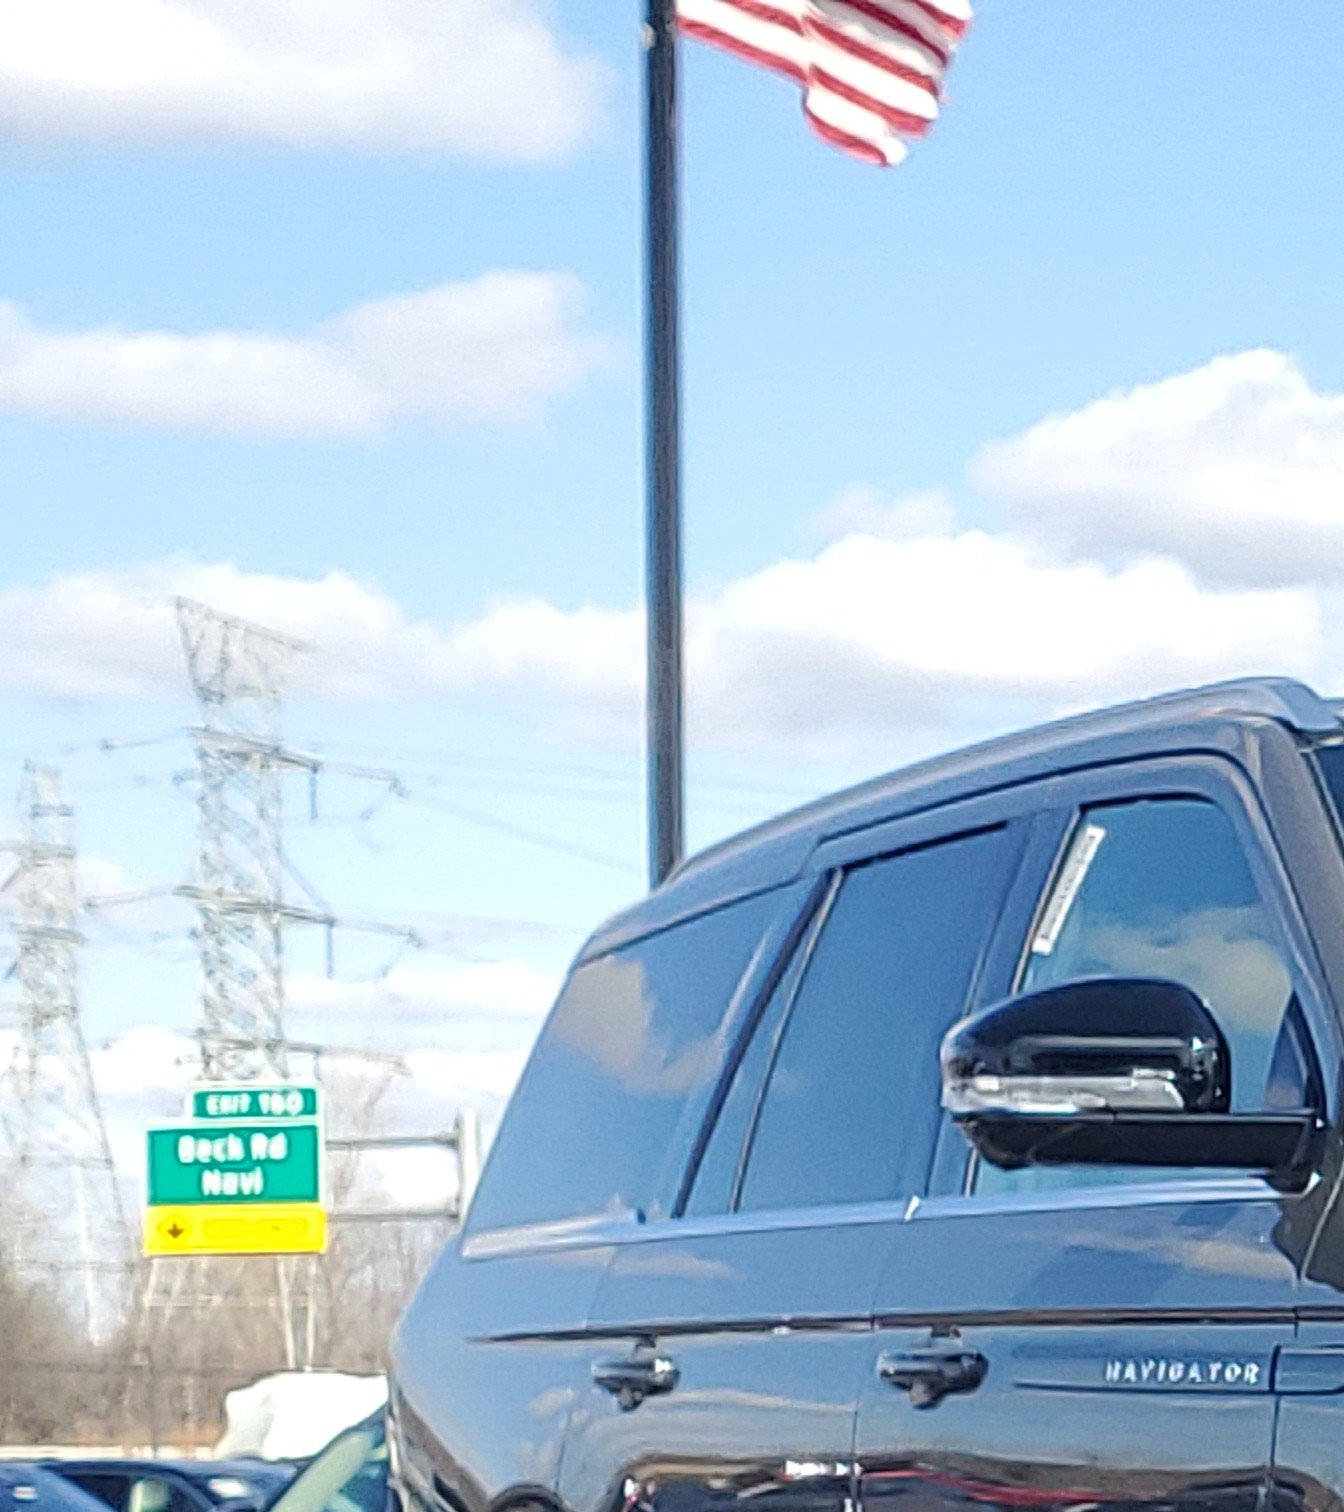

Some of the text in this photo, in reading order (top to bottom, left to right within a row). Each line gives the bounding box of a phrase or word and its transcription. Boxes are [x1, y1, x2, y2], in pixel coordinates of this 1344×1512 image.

[206, 1092, 251, 1116] EXIT
[177, 1132, 289, 1164] Beck Rd
[202, 1166, 265, 1196] Novi
[1104, 1358, 1261, 1385] NAVIGATOR
